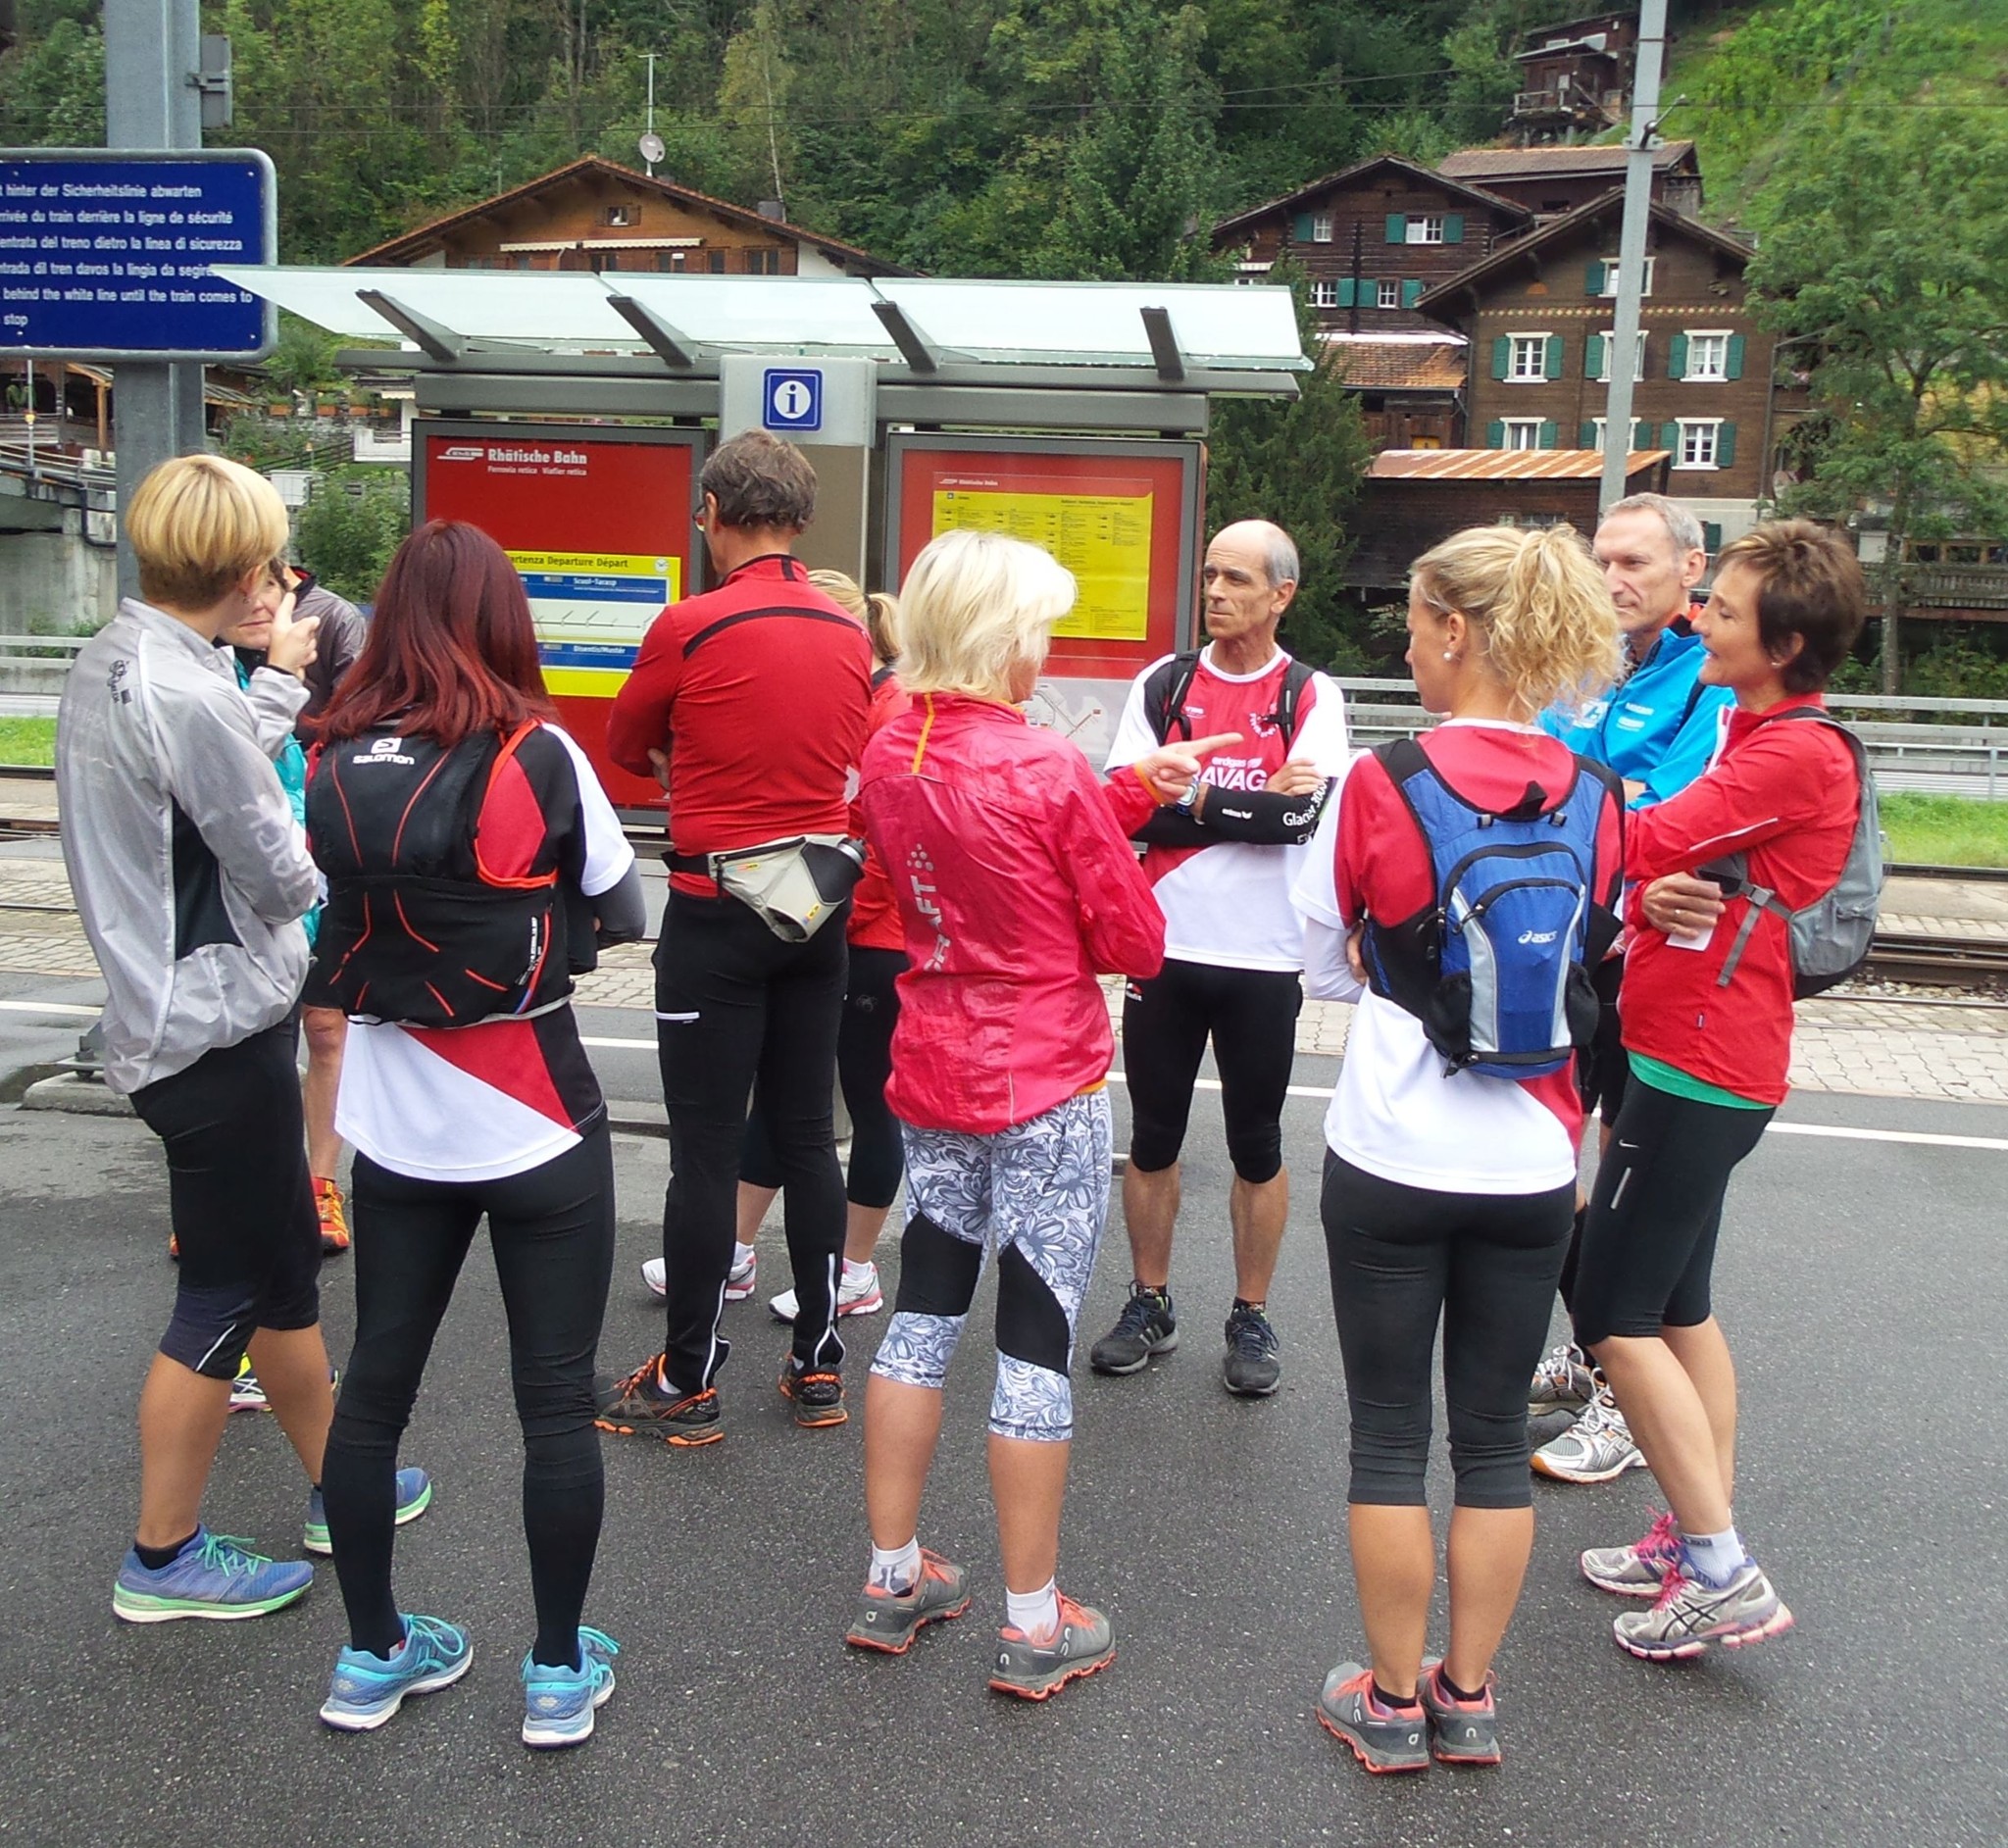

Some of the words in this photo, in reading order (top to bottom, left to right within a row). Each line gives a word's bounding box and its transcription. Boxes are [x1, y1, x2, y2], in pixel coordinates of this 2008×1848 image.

[6, 184, 37, 196] hinter
[40, 184, 59, 196] der
[63, 183, 147, 197] Sicherheitslinie
[151, 185, 202, 197] abwarten
[31, 210, 45, 223] du
[49, 211, 74, 223] train
[77, 211, 121, 224] derrière
[124, 211, 134, 223] la
[138, 211, 166, 226] ligne
[170, 211, 184, 224] de
[187, 211, 232, 224] sécurité
[40, 236, 58, 248] del
[62, 237, 90, 249] treno
[94, 236, 127, 249] dietro
[130, 237, 141, 249] la
[145, 237, 172, 250] linea
[176, 237, 186, 250] di
[189, 237, 242, 250] sicurezza
[33, 262, 47, 275] dil
[50, 263, 73, 275] tren
[76, 263, 109, 275] davos
[113, 263, 124, 275] la
[127, 263, 157, 278] lingia
[161, 264, 175, 275] da
[3, 287, 39, 300] behind
[43, 288, 60, 300] the
[65, 288, 93, 300] white
[97, 288, 117, 301] line
[121, 289, 145, 301] until
[149, 289, 167, 302] the
[171, 289, 195, 302] train
[199, 292, 237, 303] comes
[240, 291, 253, 303] to
[4, 314, 28, 326] stop
[487, 448, 550, 464] Rhätische
[554, 451, 587, 465] Bahn
[510, 556, 545, 566] artenza
[547, 556, 594, 568] Departure
[596, 557, 628, 569] Départ
[1194, 766, 1268, 792] AVAG
